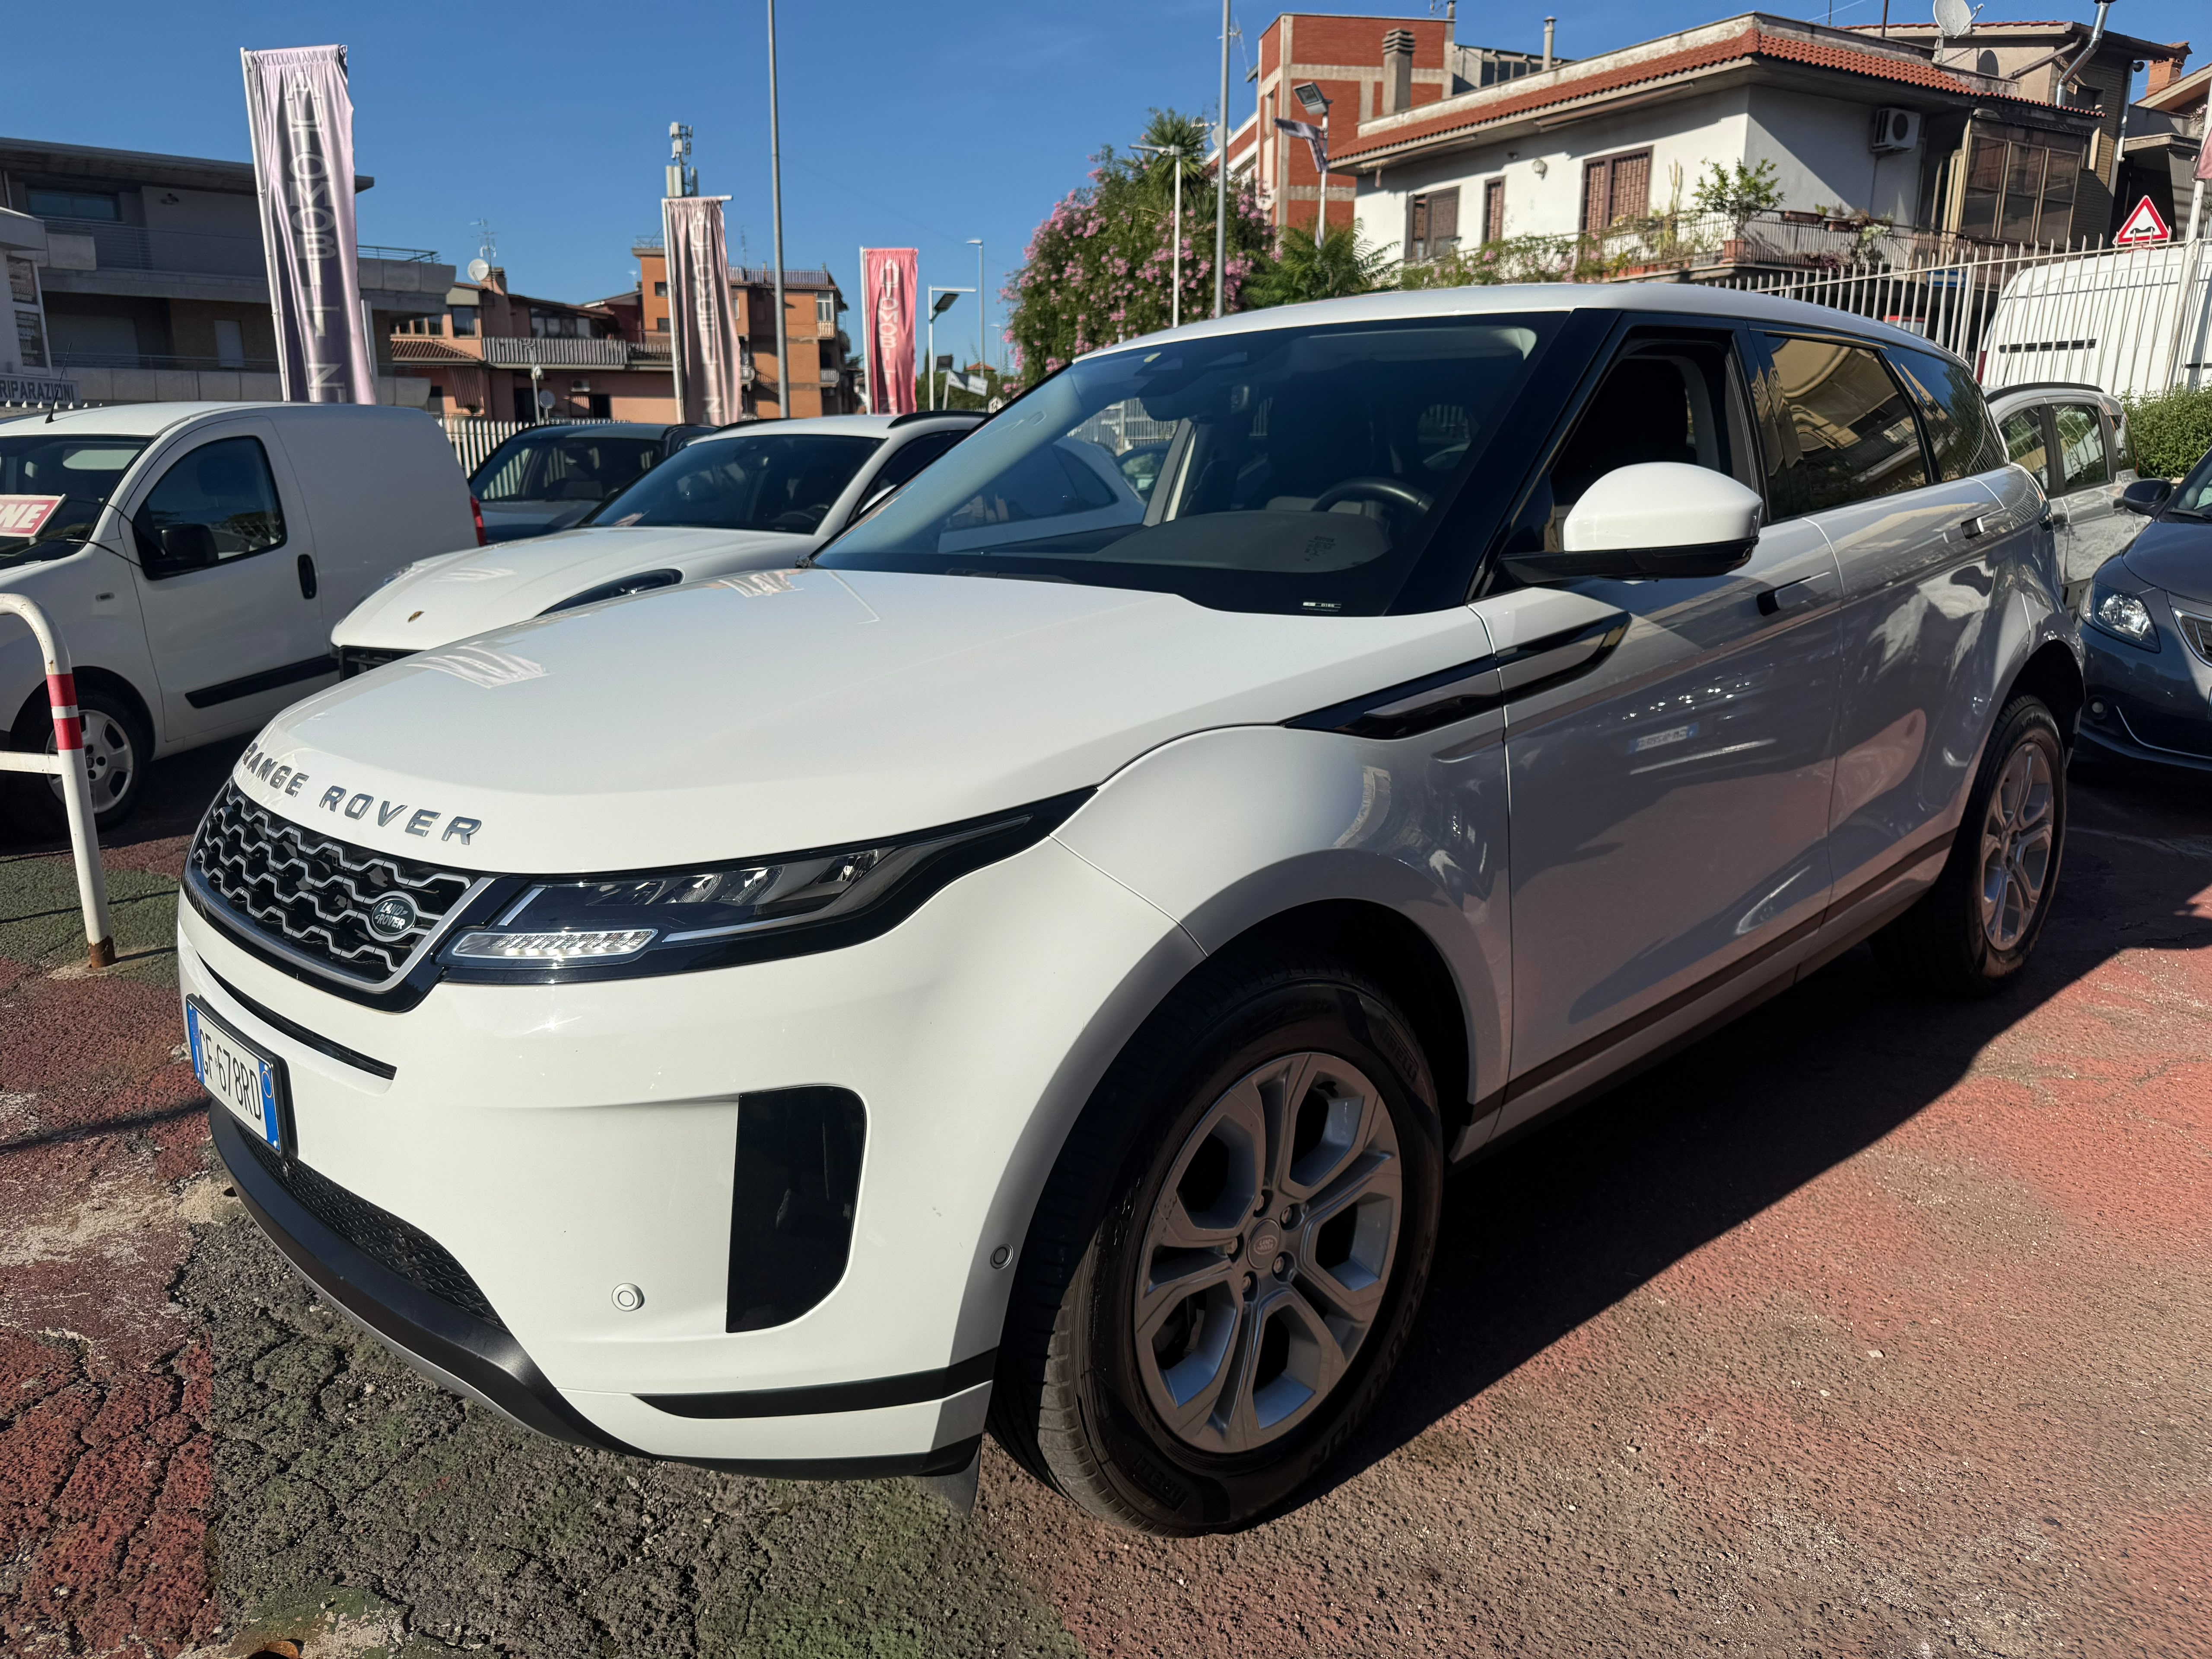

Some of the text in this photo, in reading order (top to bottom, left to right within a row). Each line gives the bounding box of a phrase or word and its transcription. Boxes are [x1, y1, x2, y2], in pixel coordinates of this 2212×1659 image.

[284, 71, 340, 338] AUTOMOBILI
[242, 741, 482, 845] RANGE ROVER
[377, 913, 406, 930] ROVER
[380, 902, 404, 915] LAND
[199, 1028, 262, 1121] GF 678RD
